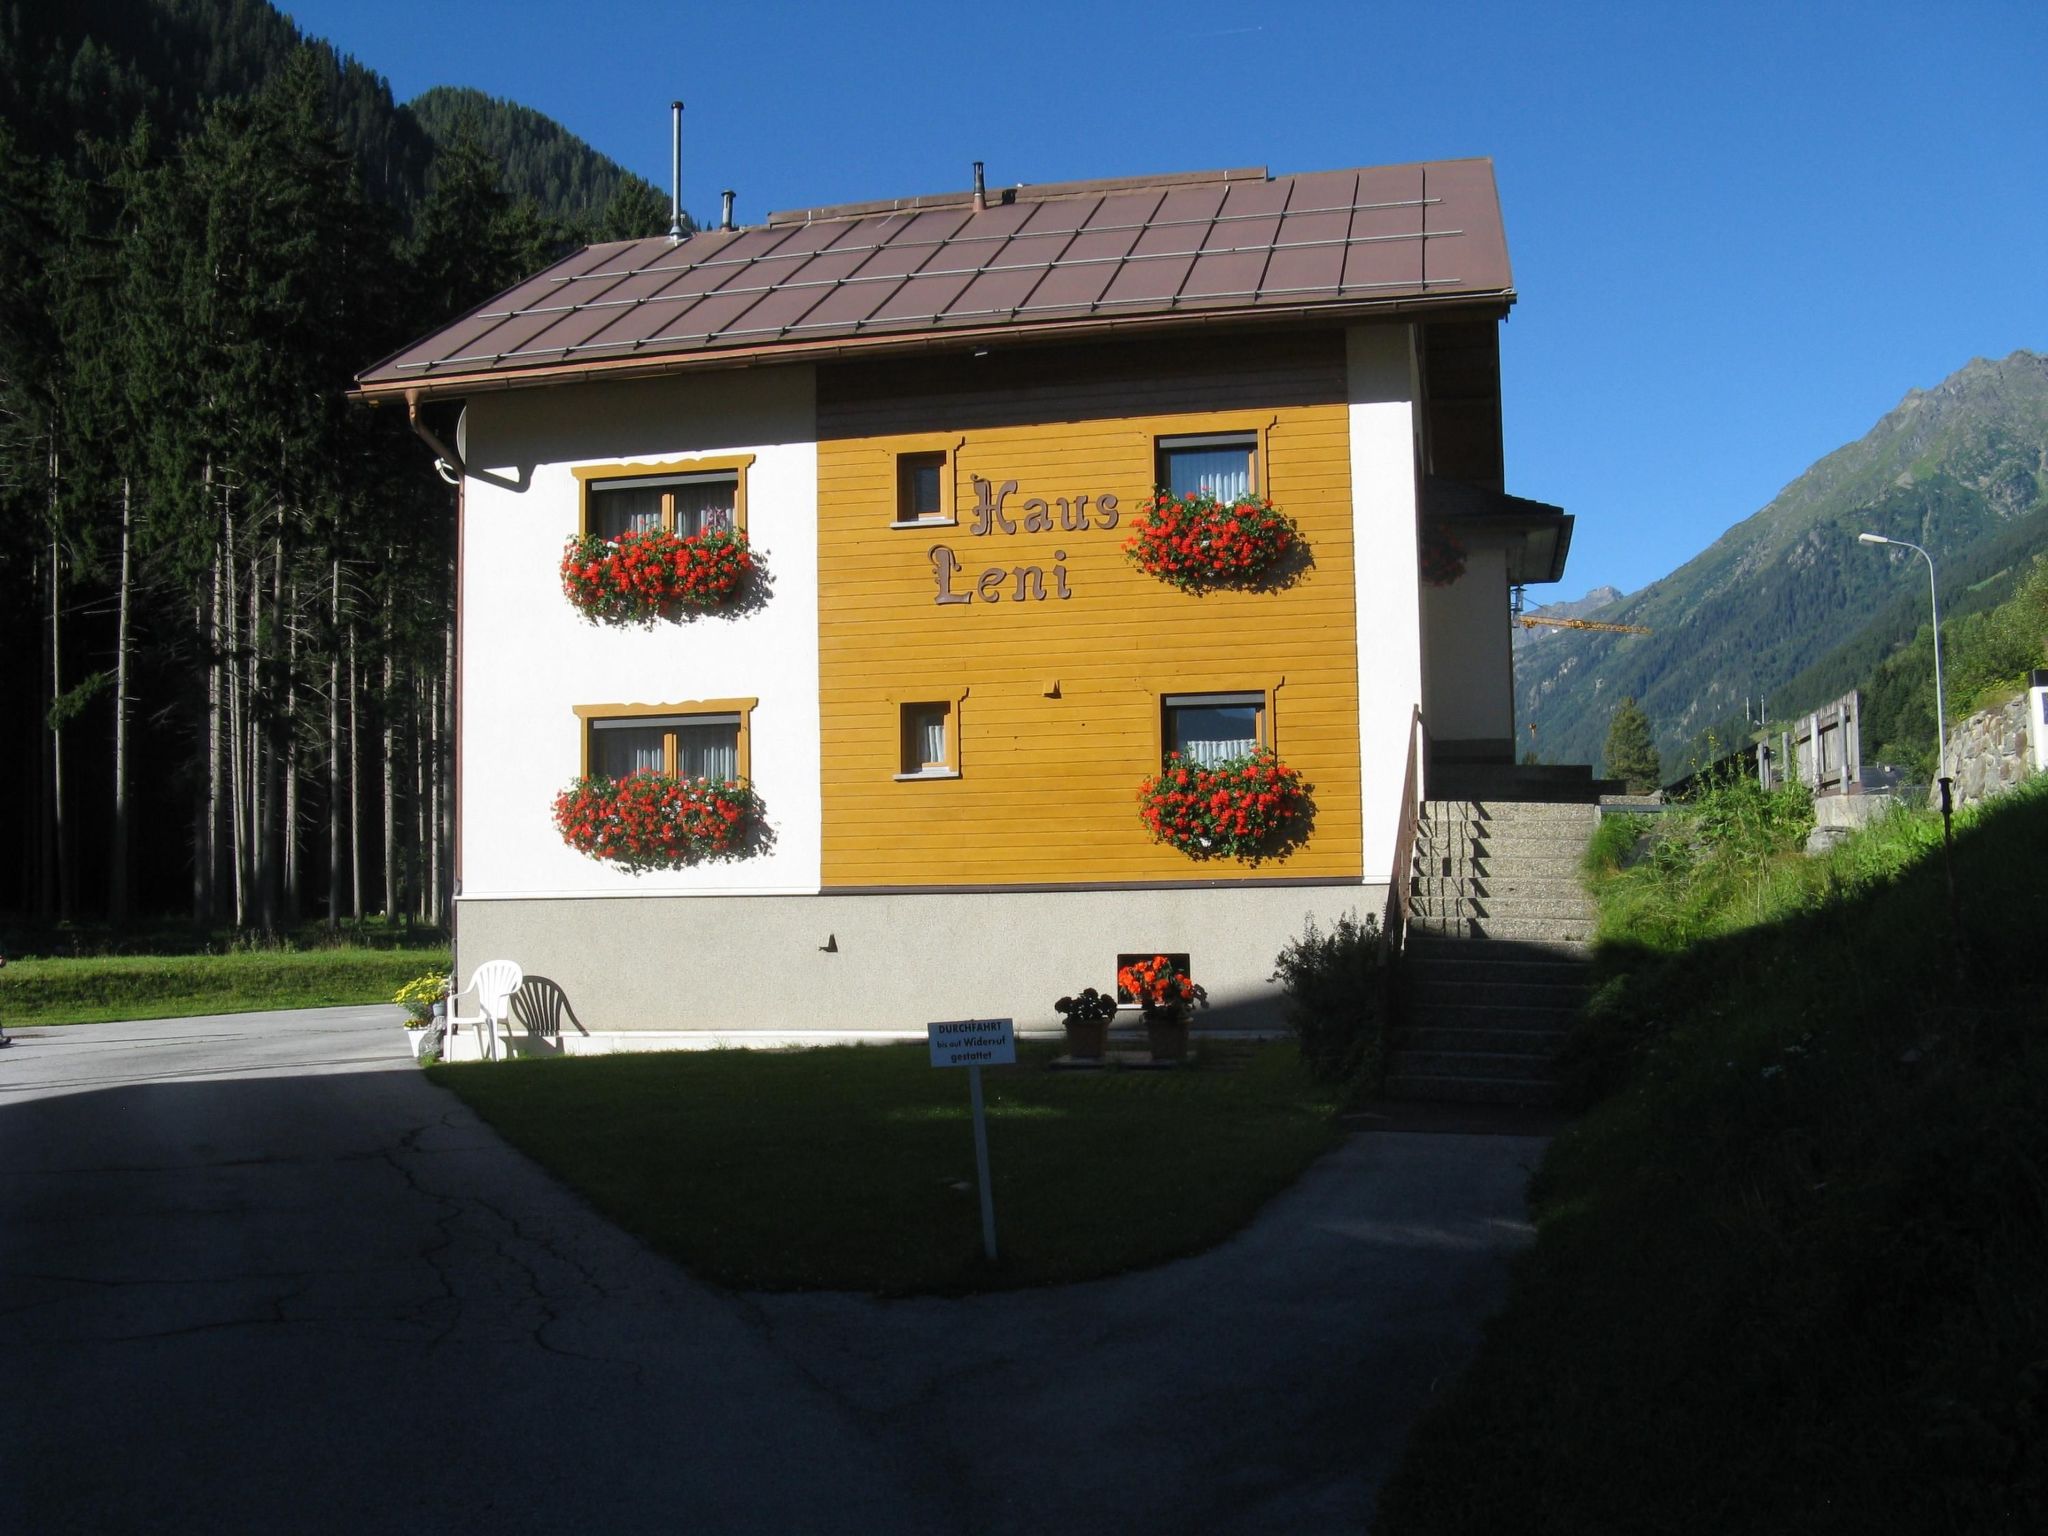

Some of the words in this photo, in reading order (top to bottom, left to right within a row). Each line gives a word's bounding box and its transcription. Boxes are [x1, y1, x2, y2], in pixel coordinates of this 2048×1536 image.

[970, 473, 1119, 535] Haus
[928, 544, 1071, 605] Leni
[938, 1022, 1002, 1033] DURCHFAHRT
[949, 1040, 961, 1048] auf
[963, 1035, 1005, 1047] Widerruf
[951, 1052, 992, 1063] gestattet
